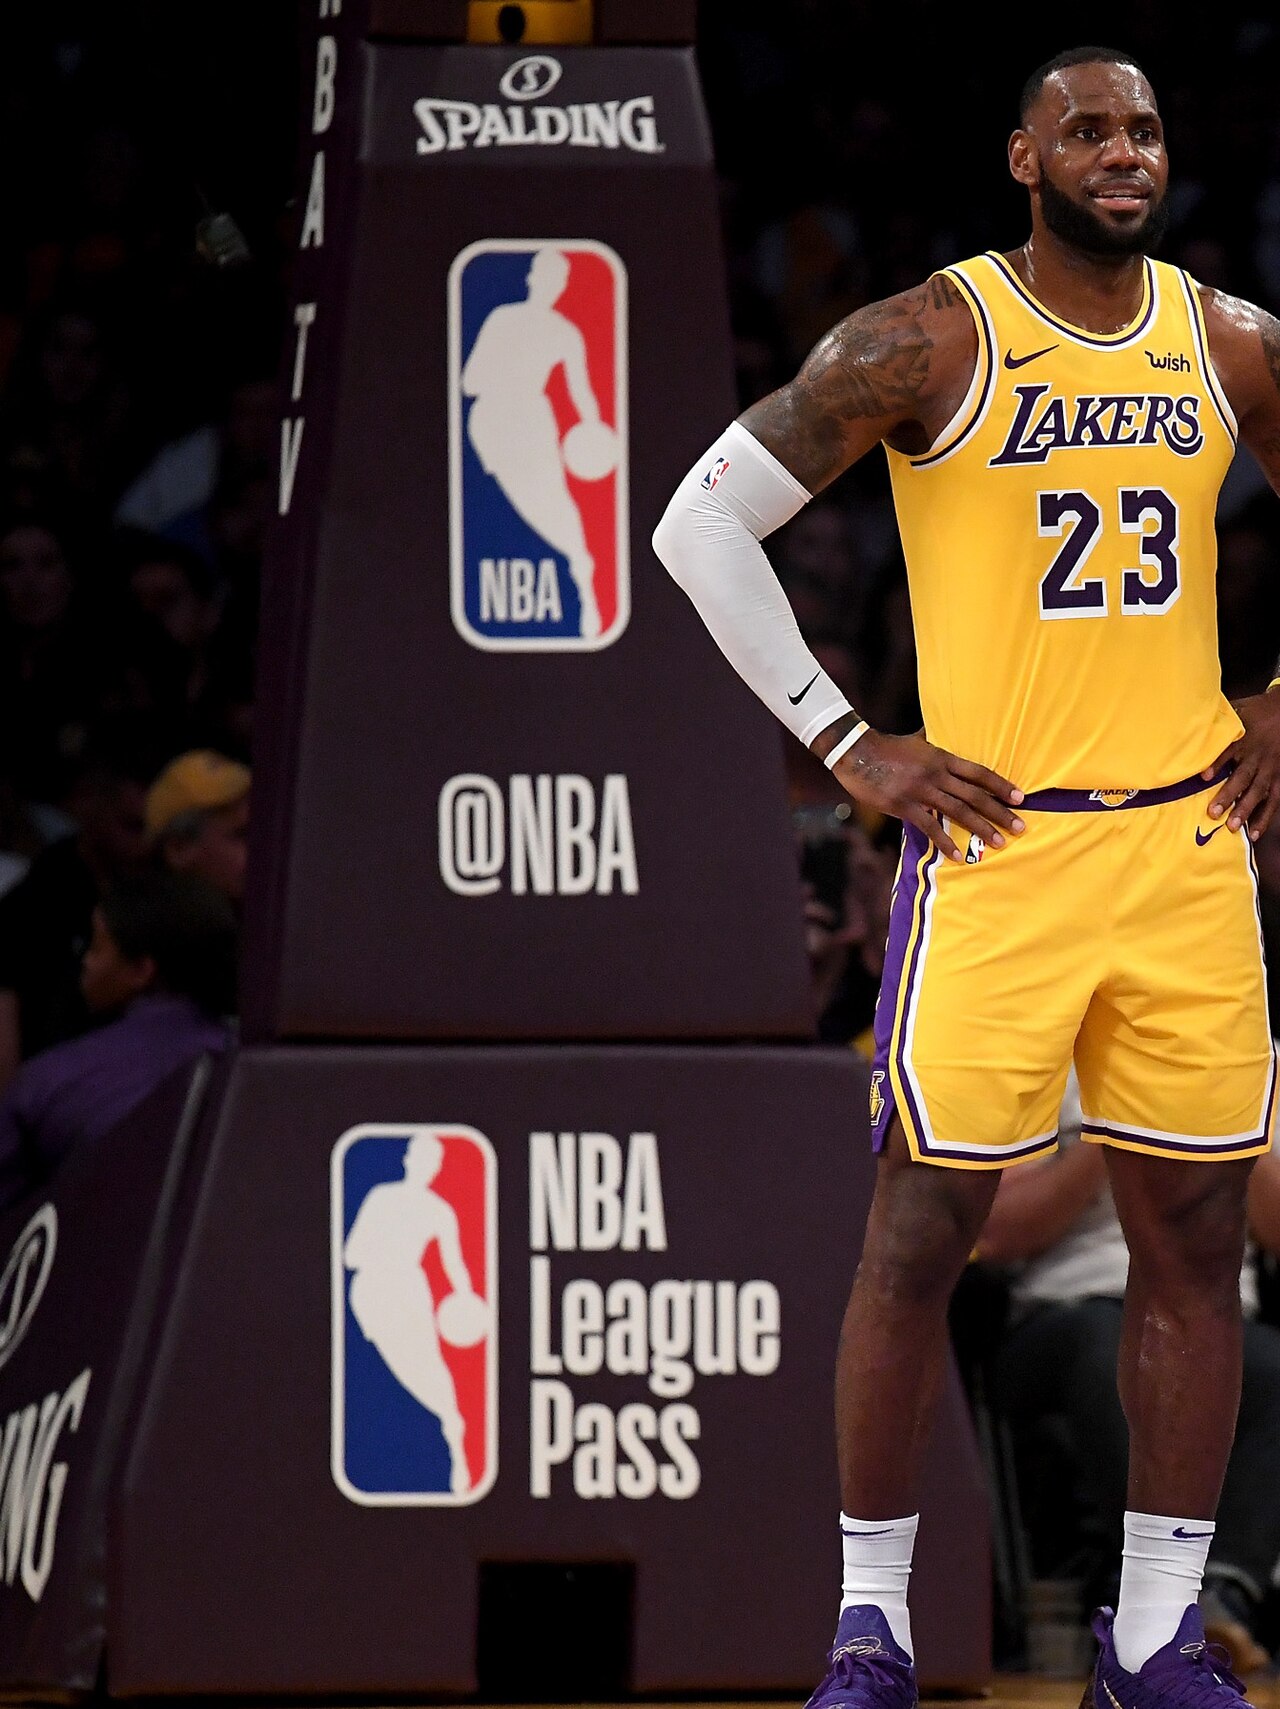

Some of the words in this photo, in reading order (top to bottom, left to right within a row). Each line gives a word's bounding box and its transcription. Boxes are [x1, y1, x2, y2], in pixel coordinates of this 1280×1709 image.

[300, 0, 342, 248] BA
[413, 96, 664, 154] SPALDING
[278, 302, 317, 517] TV
[1144, 350, 1190, 373] wish
[986, 382, 1205, 468] LAKERS
[479, 557, 564, 623] NBA
[1036, 486, 1182, 620] 23
[438, 773, 640, 896] @NBA
[529, 1132, 668, 1252] NBA
[530, 1254, 782, 1398] League
[530, 1378, 701, 1500] Pass
